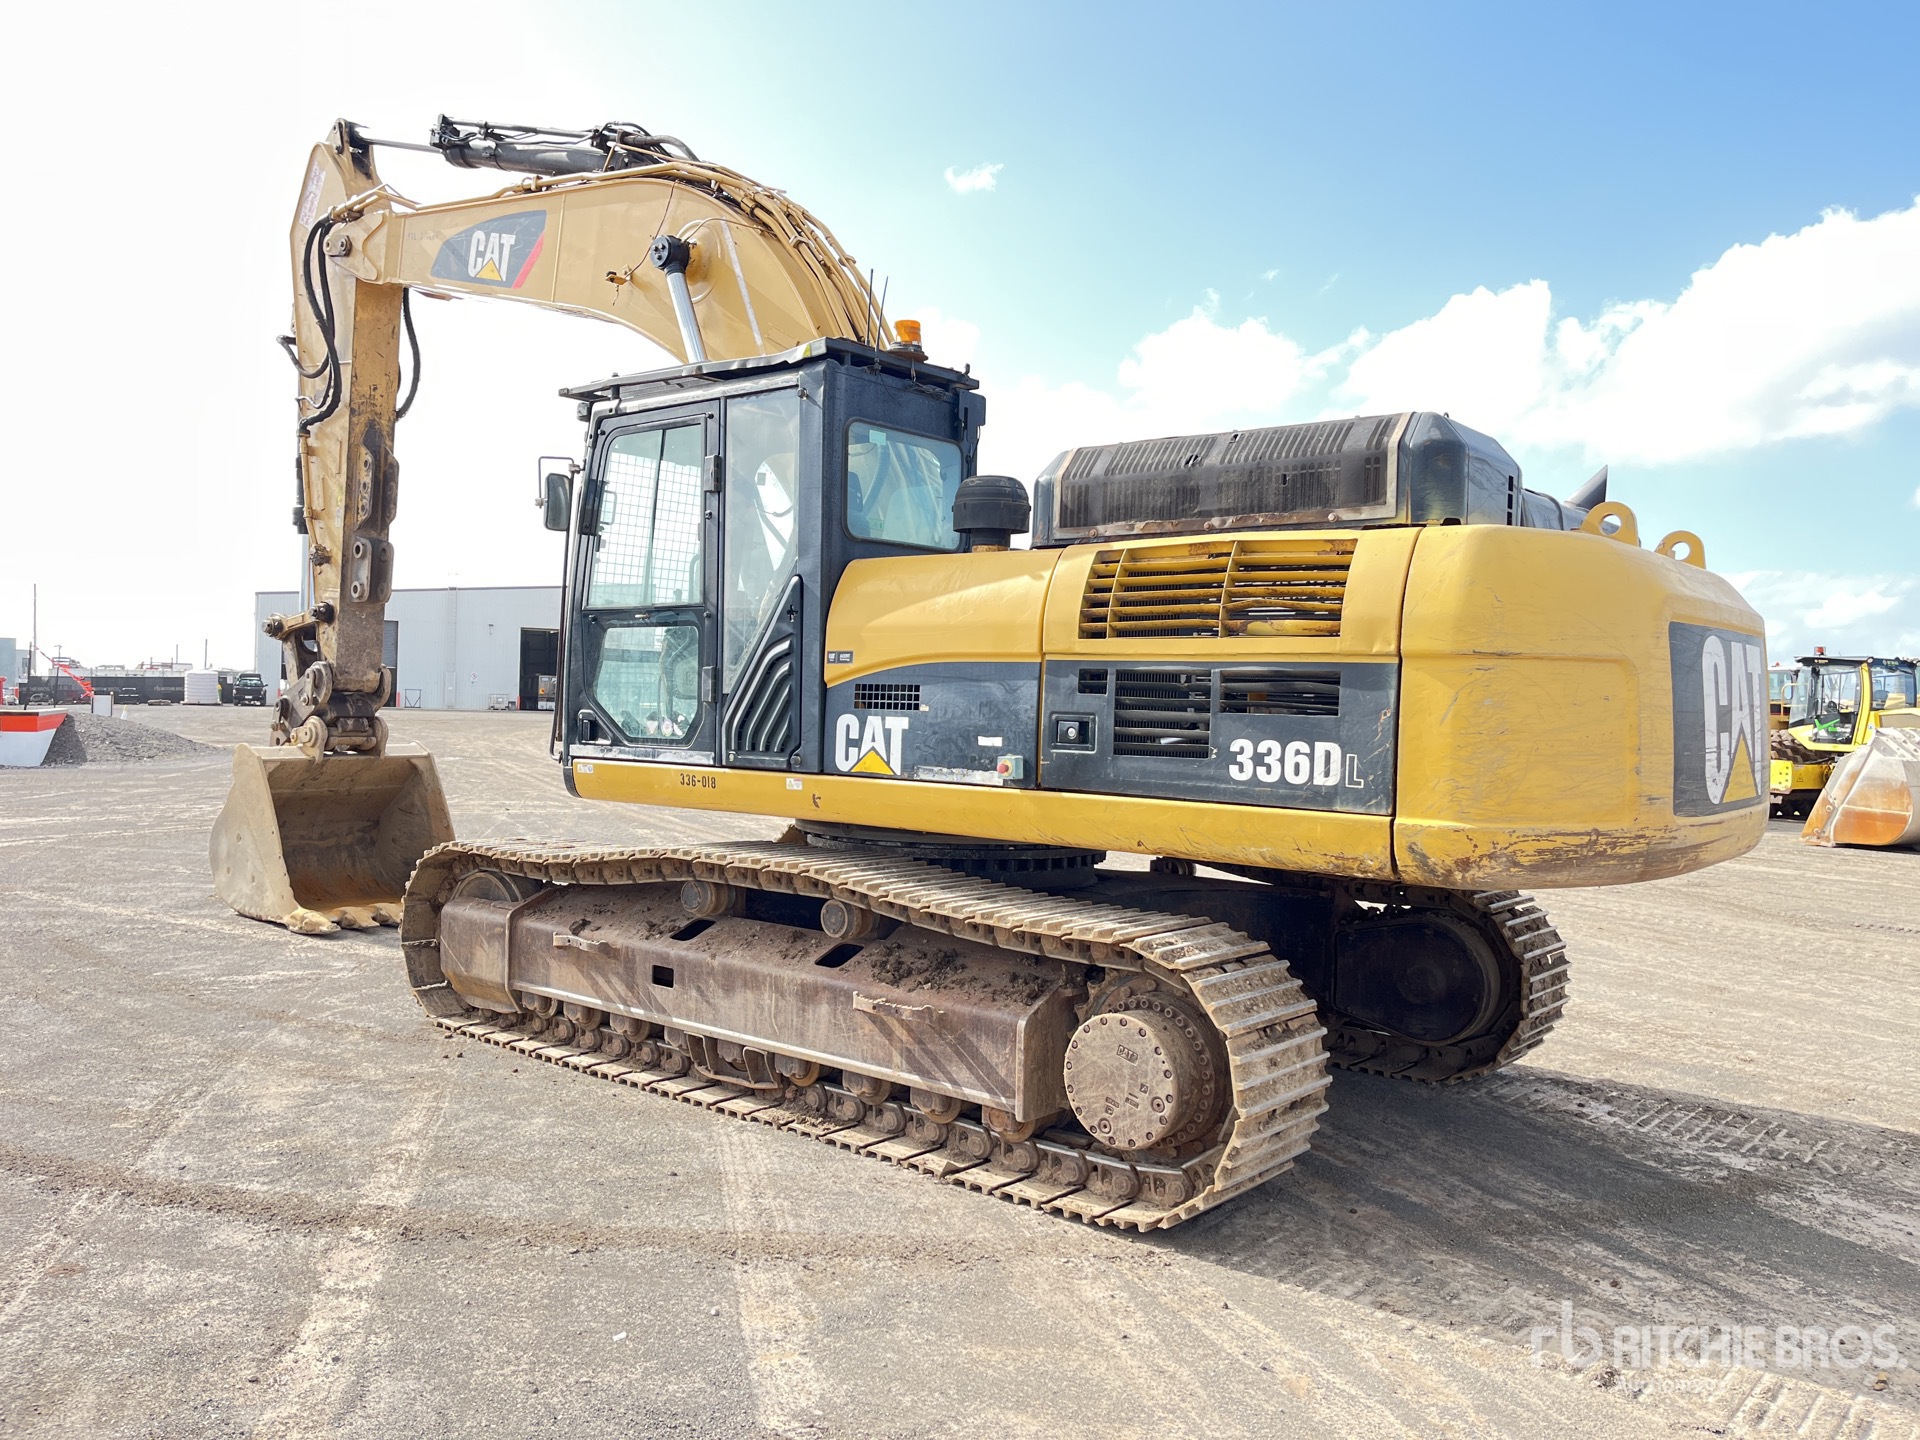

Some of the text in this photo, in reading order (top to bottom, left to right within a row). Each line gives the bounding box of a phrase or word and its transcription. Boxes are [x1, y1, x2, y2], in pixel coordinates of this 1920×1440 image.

[468, 231, 516, 281] CAT
[835, 713, 909, 776] CAT
[1703, 635, 1762, 804] CAT
[680, 773, 716, 789] 336-018
